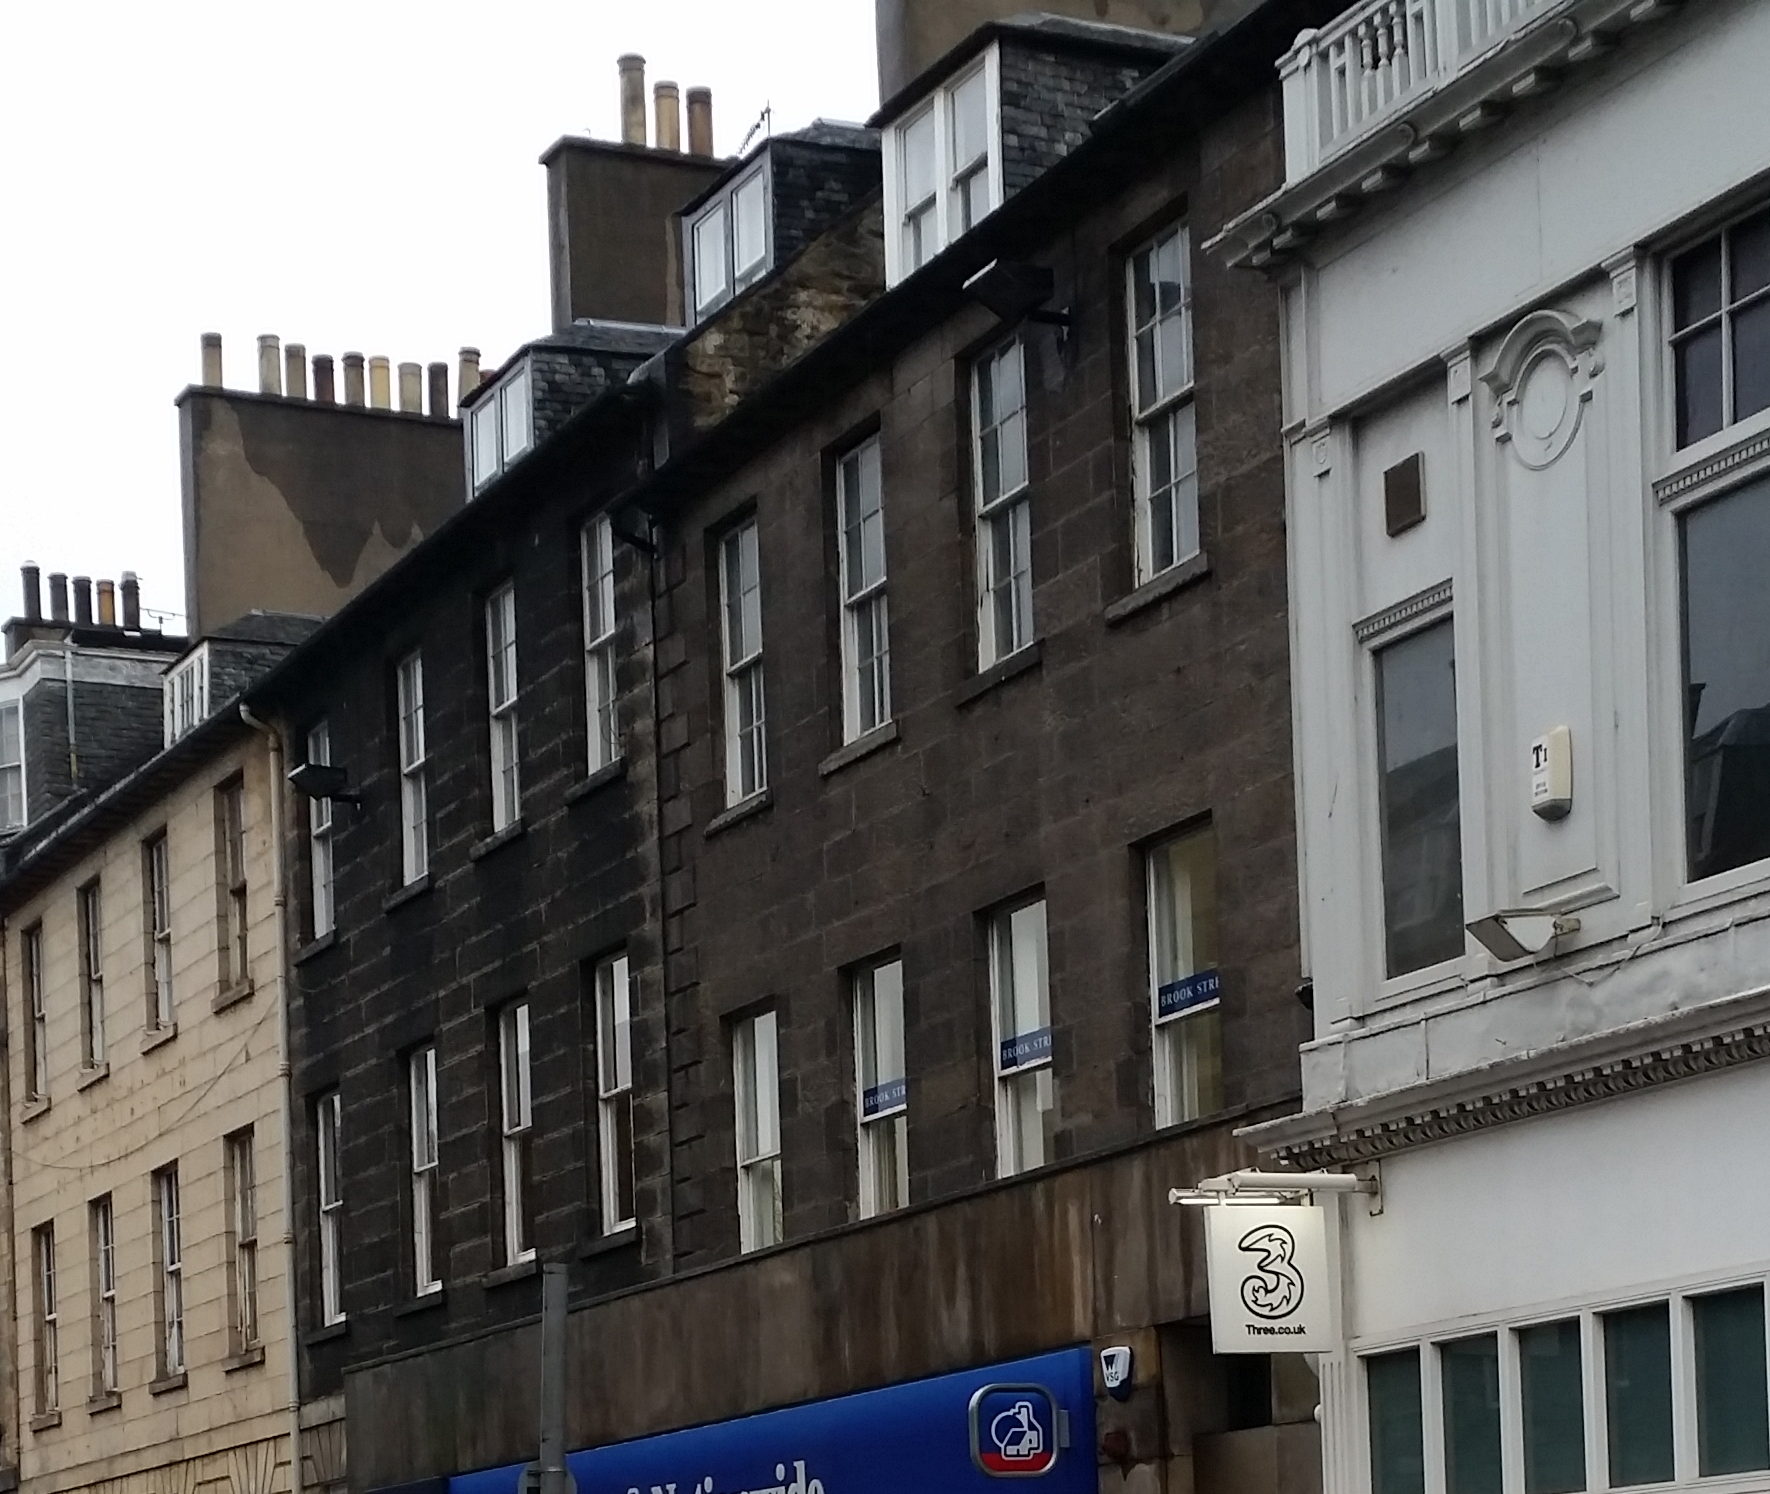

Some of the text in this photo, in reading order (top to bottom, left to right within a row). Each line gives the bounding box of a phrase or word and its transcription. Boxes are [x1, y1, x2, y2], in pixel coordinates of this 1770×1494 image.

[1160, 985, 1194, 1007] BROOK
[1002, 1042, 1031, 1061] BROOK
[1237, 1224, 1305, 1320] 3
[1244, 1324, 1307, 1336] Three.co.uk
